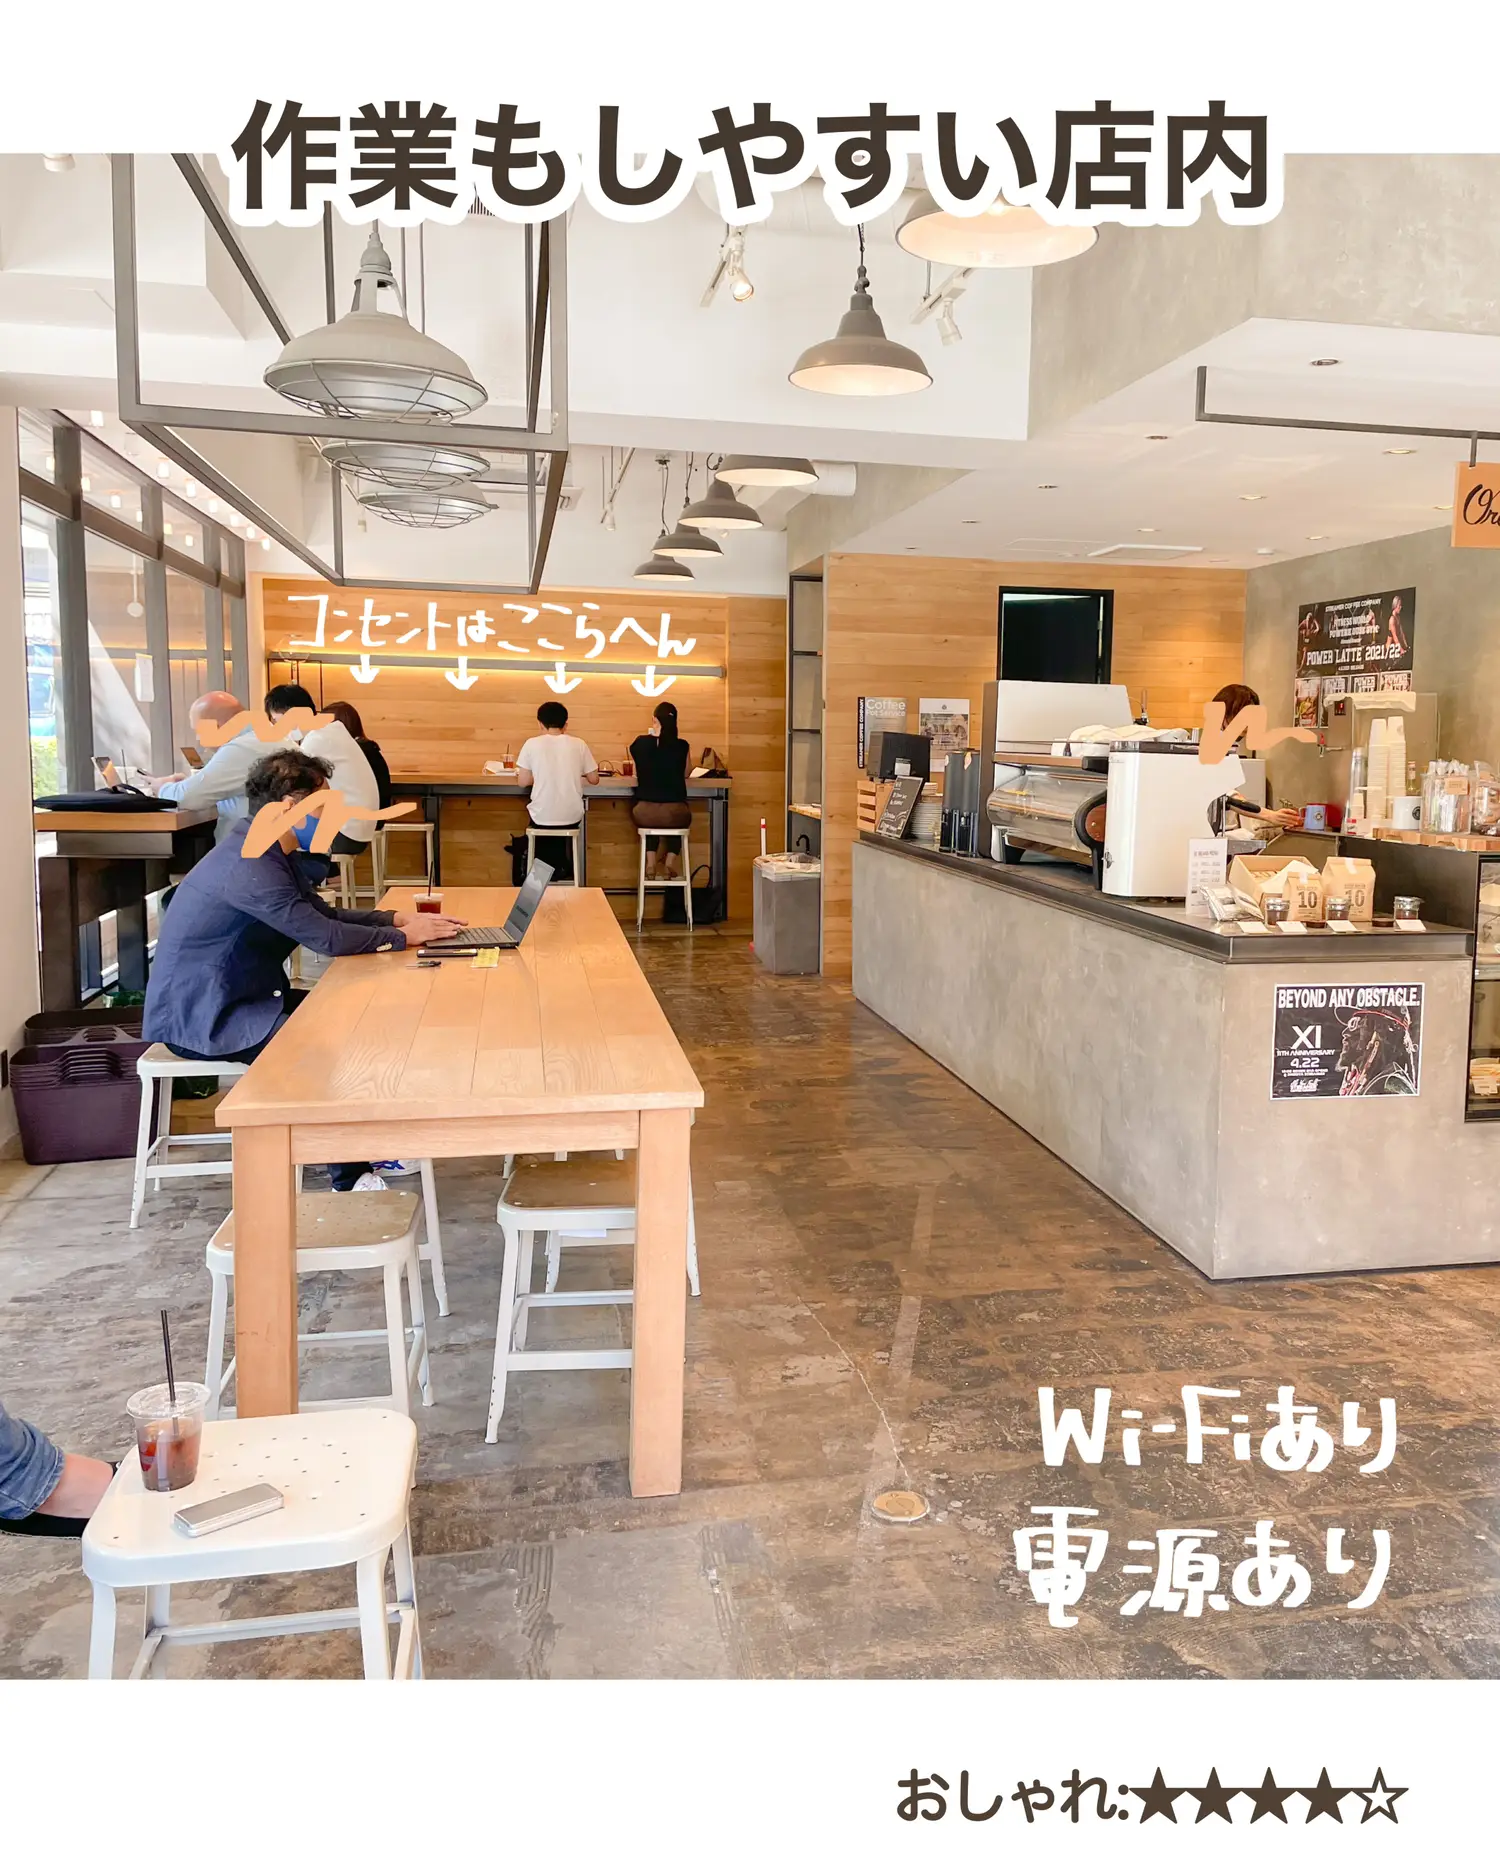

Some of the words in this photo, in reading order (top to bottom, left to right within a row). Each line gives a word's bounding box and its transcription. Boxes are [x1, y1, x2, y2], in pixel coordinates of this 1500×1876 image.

[1306, 650, 1333, 666] POWER
[1335, 647, 1362, 663] LATTE
[1365, 643, 1401, 661] 2021/22
[867, 699, 906, 710] Coffee
[1298, 891, 1318, 908] 10
[1278, 989, 1327, 1008] BEYOND
[1329, 988, 1354, 1008] ANY
[1357, 987, 1420, 1008] OBSTACLE.
[1290, 1025, 1322, 1050] XI
[1290, 1057, 1320, 1068] 4.22
